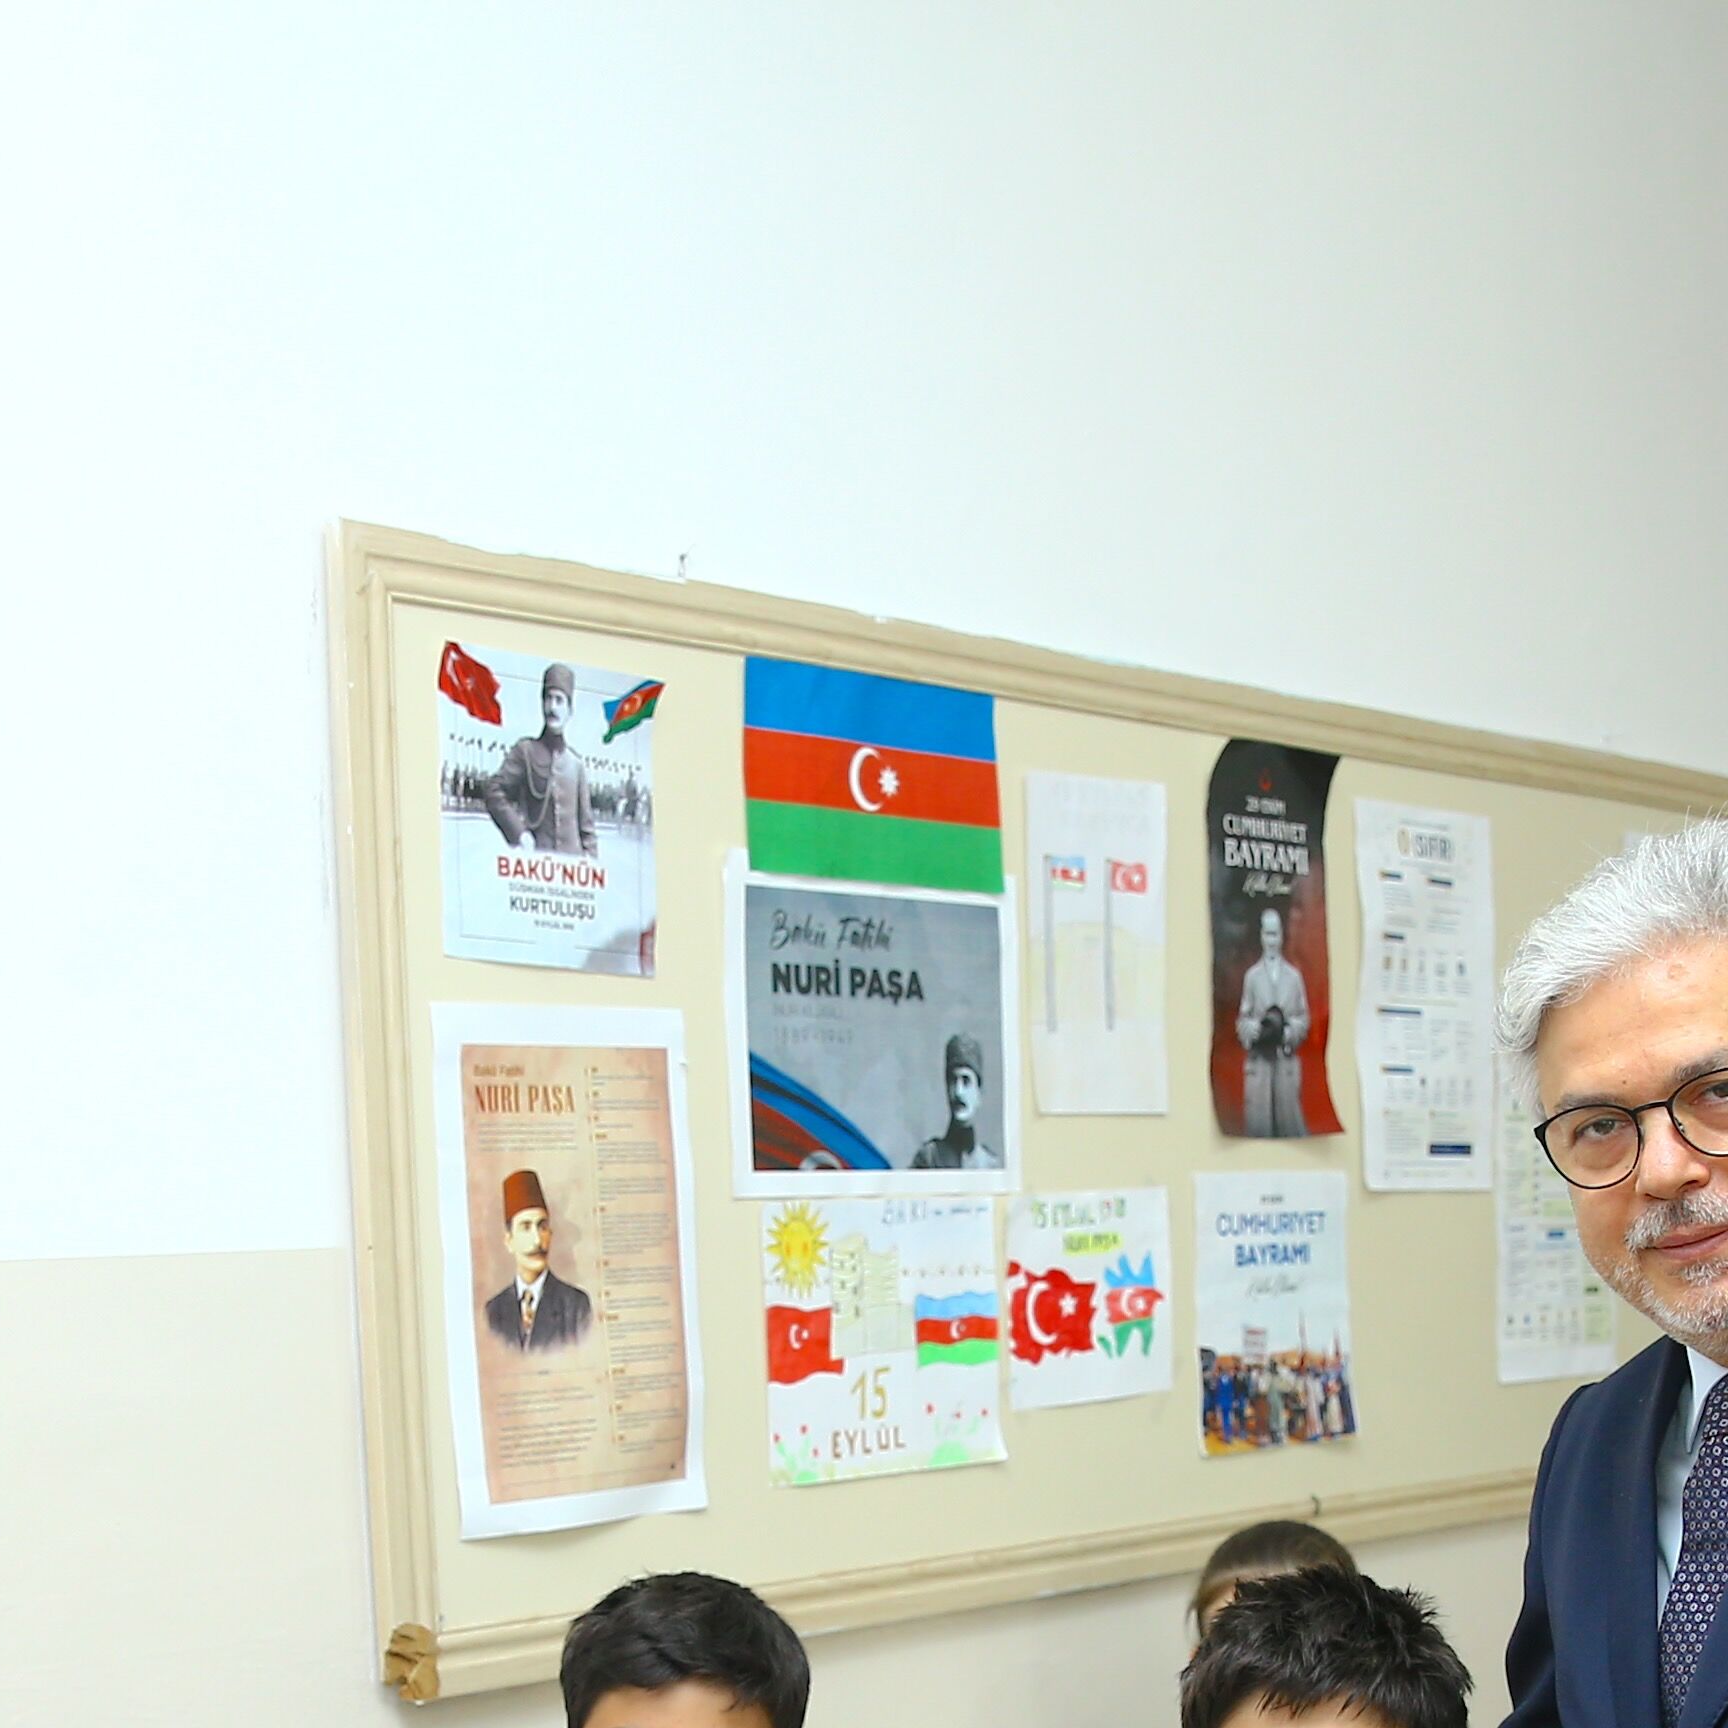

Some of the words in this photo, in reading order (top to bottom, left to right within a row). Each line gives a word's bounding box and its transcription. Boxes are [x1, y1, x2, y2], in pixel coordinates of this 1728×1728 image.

[497, 855, 605, 889] BAKÜ'NÜN
[509, 895, 595, 921] KURTULUŞU
[772, 958, 841, 997] NURİ
[850, 966, 925, 1006] PAŞA
[474, 1081, 520, 1114] NURİ
[526, 1084, 576, 1115] PAŞA
[1234, 1242, 1311, 1267] BAYRAMI
[851, 1366, 892, 1421] 15
[831, 1424, 907, 1460] EYLÜL
